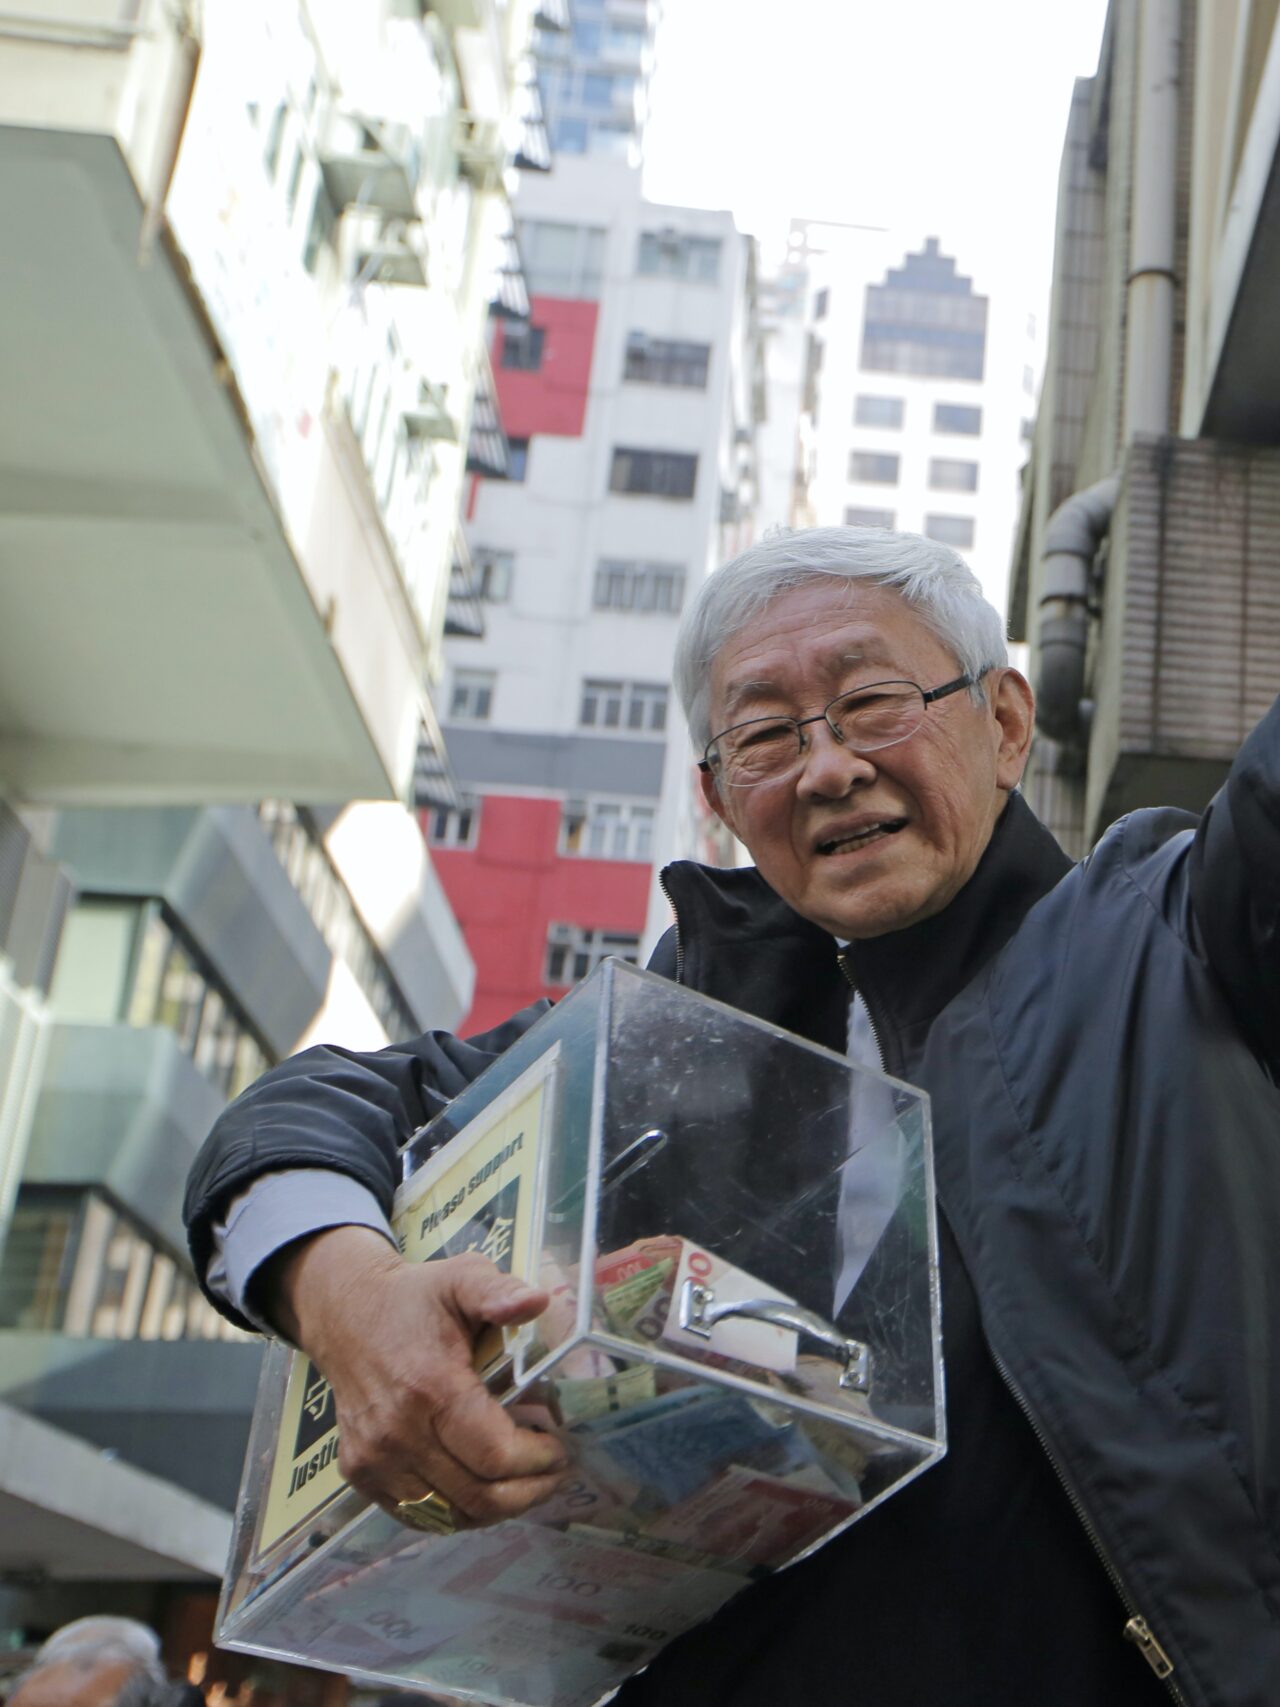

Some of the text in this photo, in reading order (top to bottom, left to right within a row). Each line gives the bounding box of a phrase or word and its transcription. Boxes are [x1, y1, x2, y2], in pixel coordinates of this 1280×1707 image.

[420, 1131, 524, 1240] Please support
[536, 1573, 602, 1598] 100
[623, 1623, 668, 1641] 100
